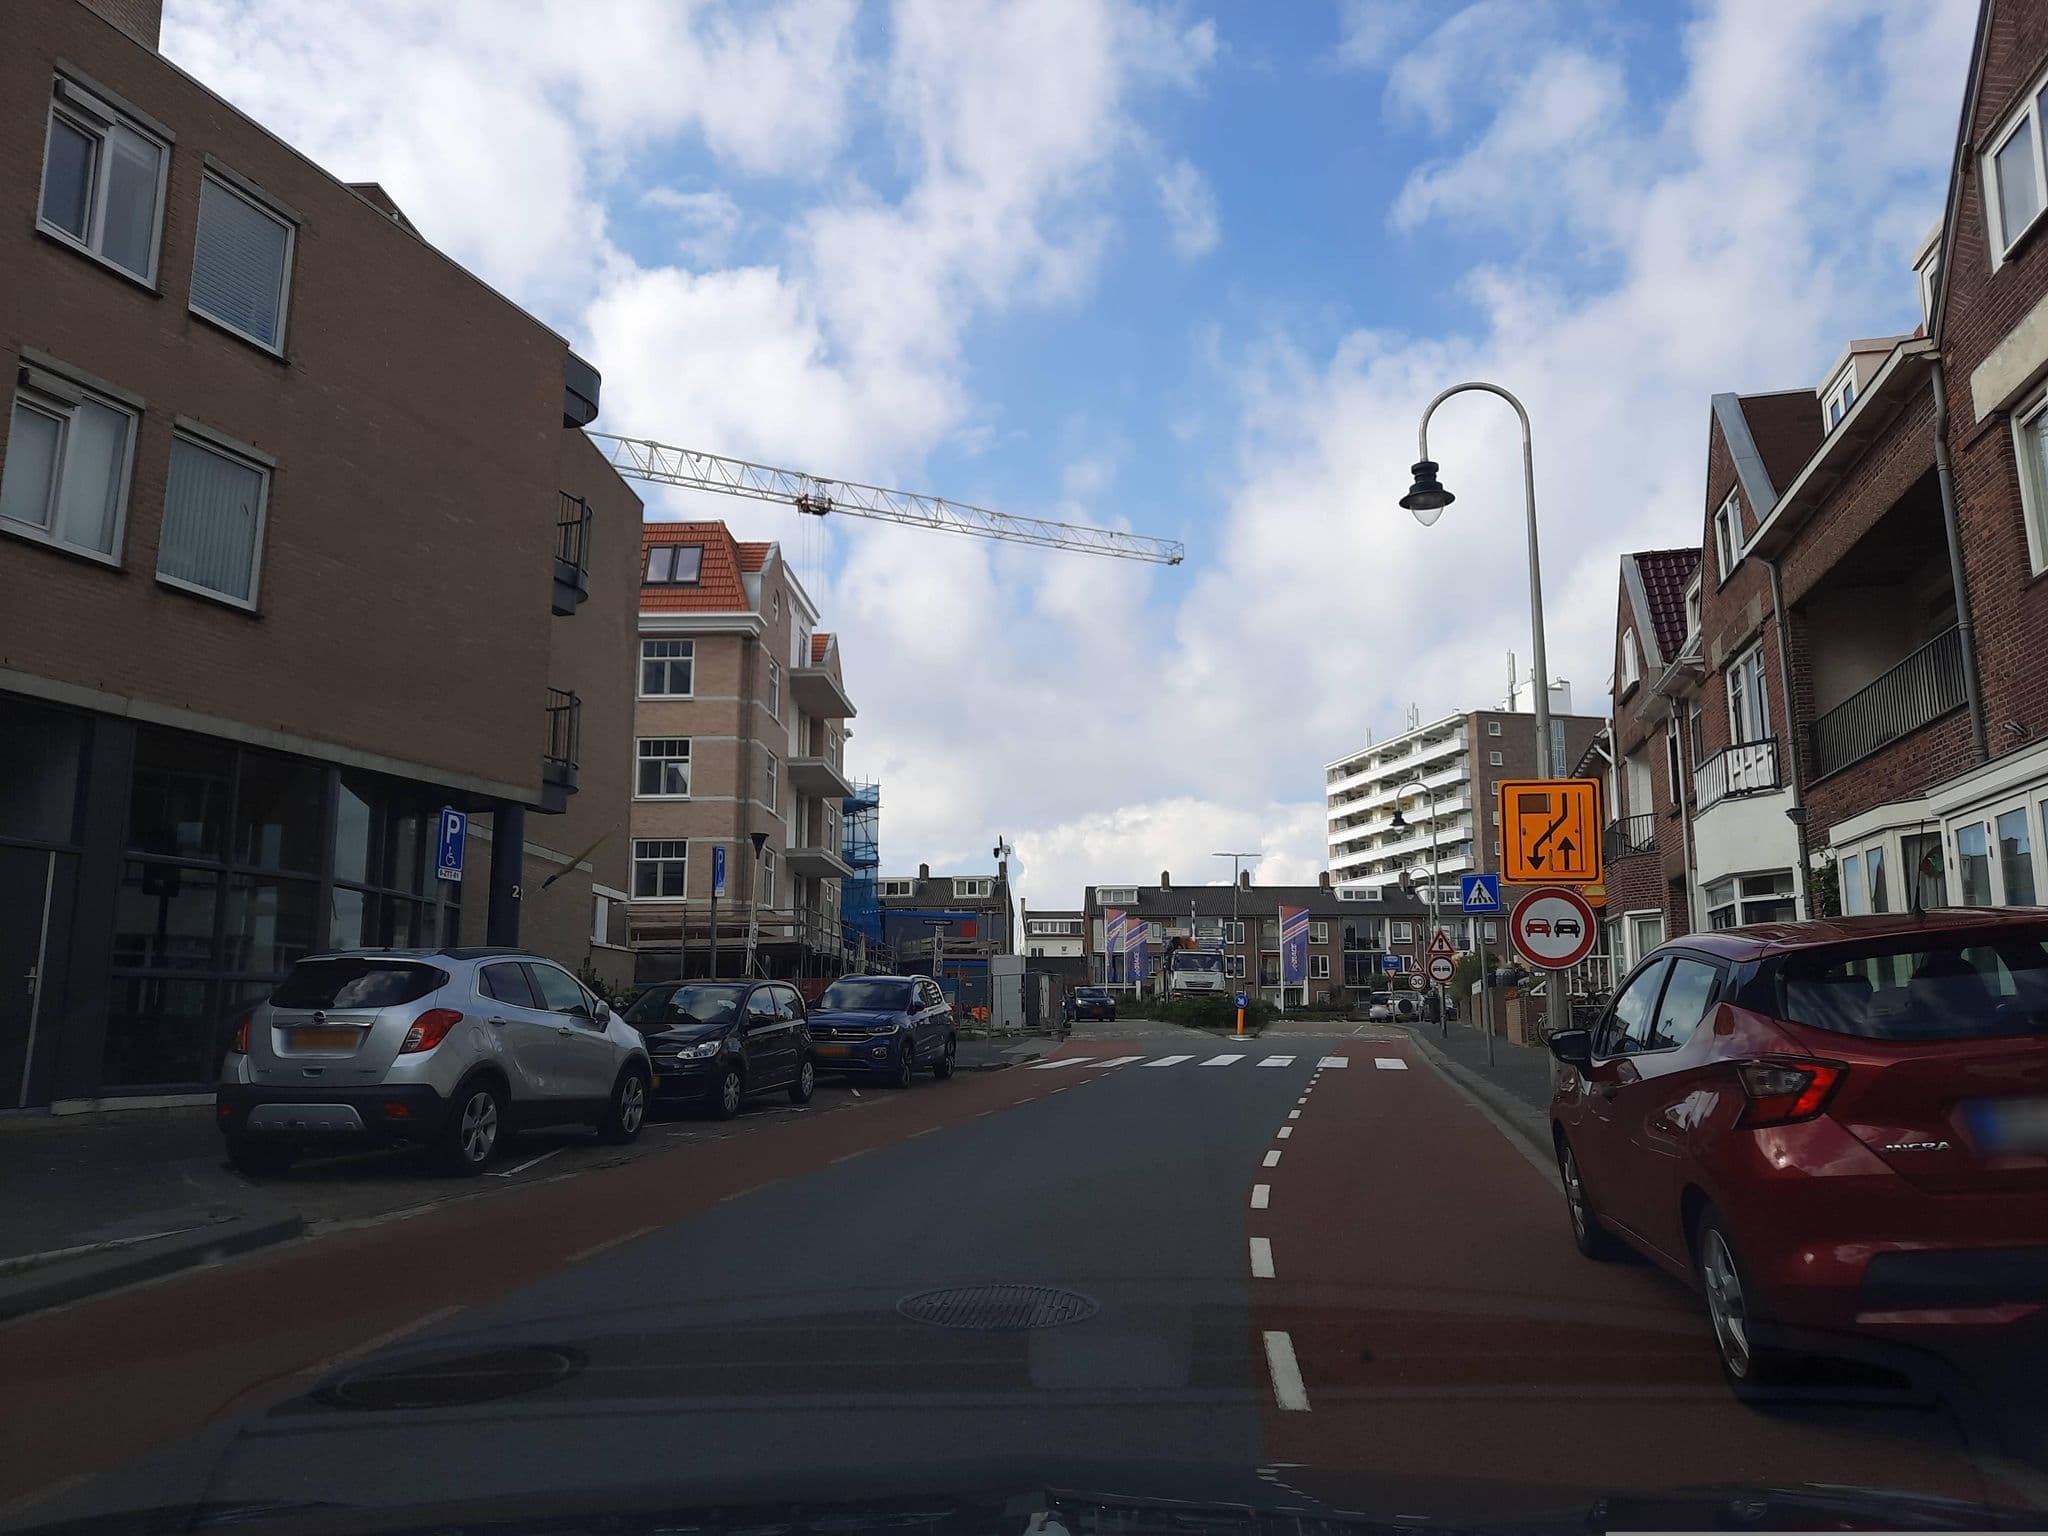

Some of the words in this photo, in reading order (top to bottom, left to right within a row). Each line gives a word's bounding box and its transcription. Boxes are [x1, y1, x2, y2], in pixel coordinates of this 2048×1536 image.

[446, 814, 461, 844] P
[717, 850, 724, 872] P
[1411, 978, 1423, 986] 30
